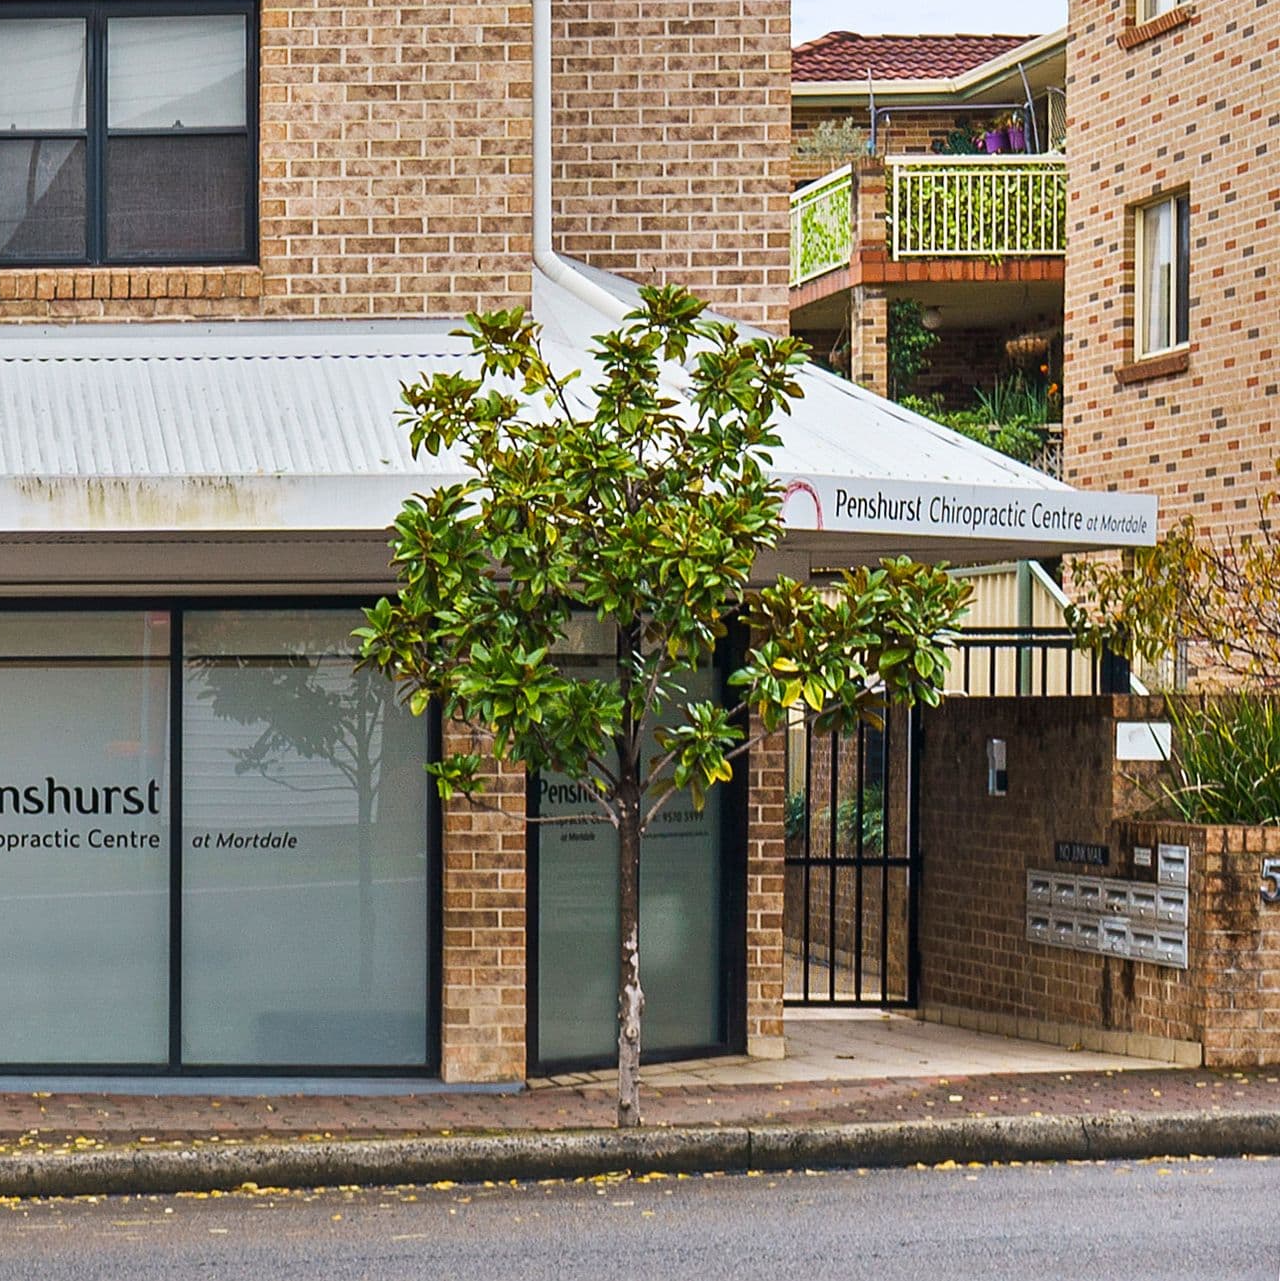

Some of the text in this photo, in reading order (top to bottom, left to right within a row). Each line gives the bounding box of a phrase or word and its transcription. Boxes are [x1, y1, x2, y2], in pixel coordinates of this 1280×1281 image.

[835, 488, 1148, 534] Penshurst Chiropractic Centre at Mortdale
[87, 828, 161, 849] Centre
[191, 833, 212, 849] at
[216, 831, 298, 849] Mortdale
